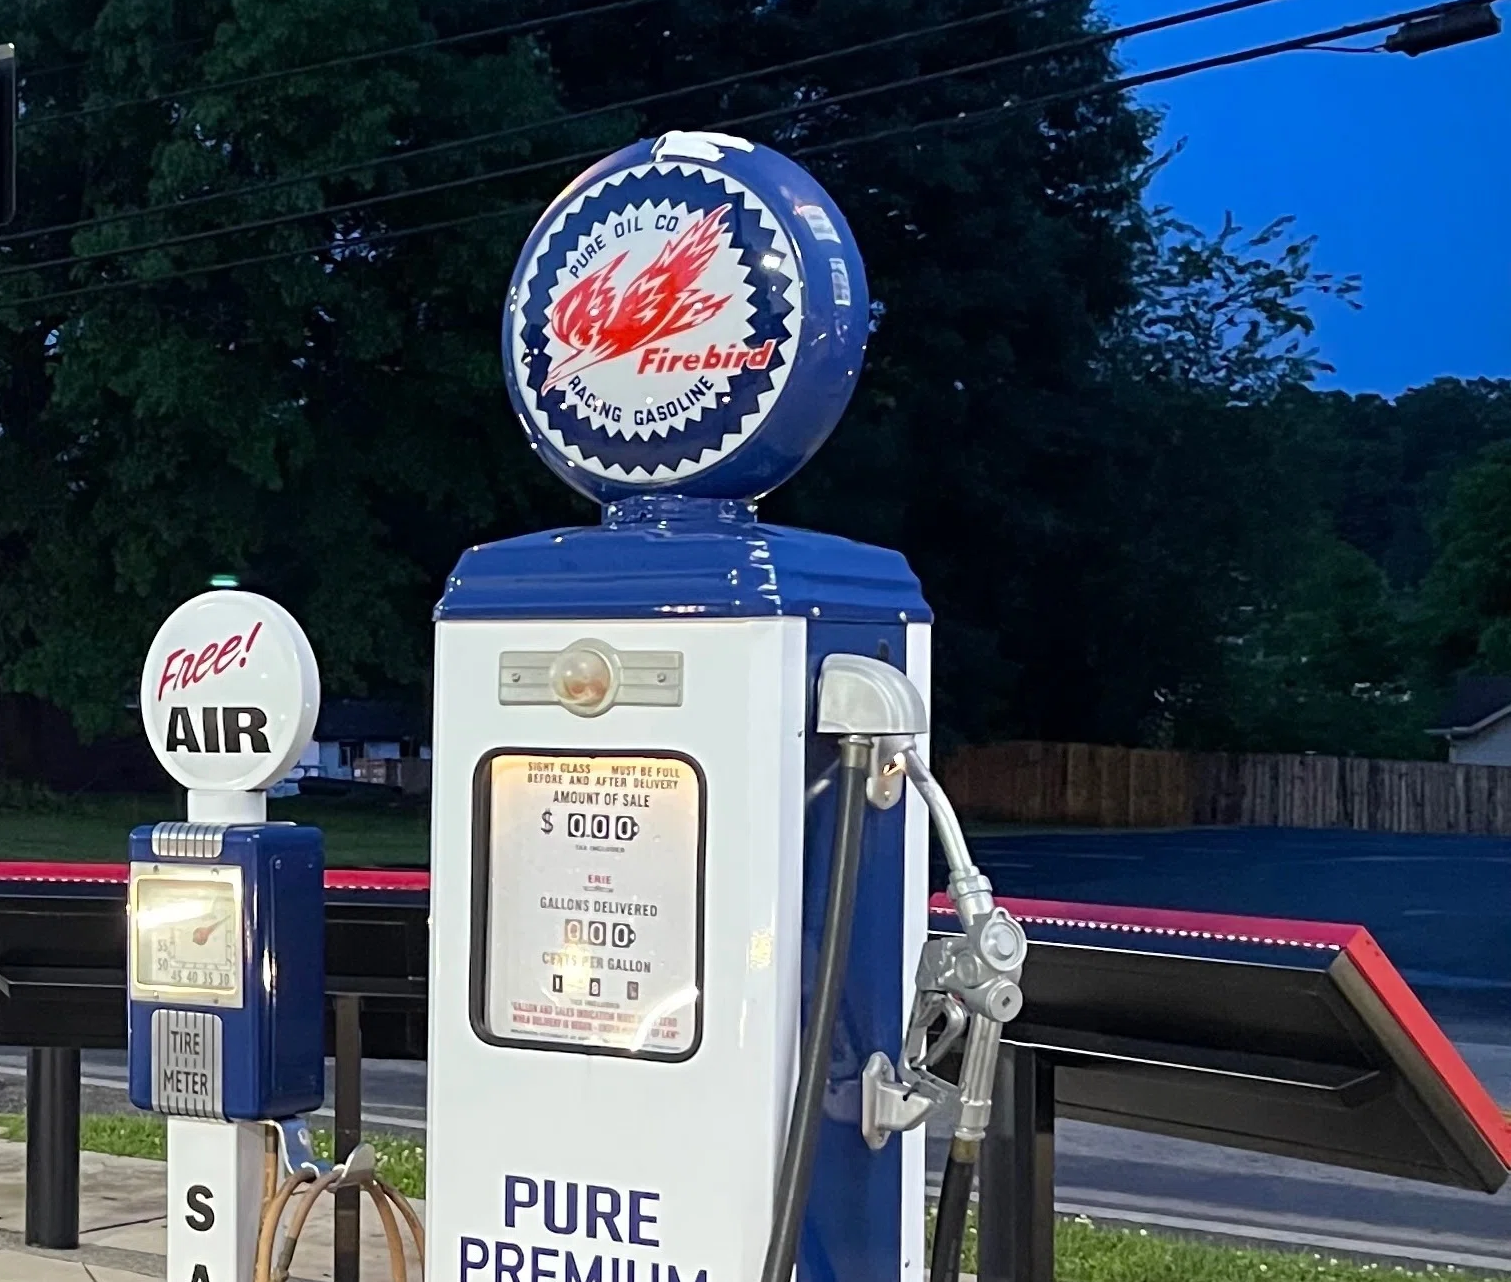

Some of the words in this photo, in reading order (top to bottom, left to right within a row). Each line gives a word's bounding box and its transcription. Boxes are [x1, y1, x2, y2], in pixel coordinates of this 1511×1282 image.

[569, 234, 607, 278] PURE
[614, 216, 643, 238] OIL
[637, 341, 774, 374] Firebird
[568, 375, 622, 423] RACING
[634, 376, 714, 425] GASOLINE
[158, 621, 262, 702] Free!
[166, 707, 271, 753] AIR
[527, 773, 563, 785] BEFORE
[569, 775, 589, 786] AND
[595, 776, 627, 787] AFTER
[633, 777, 679, 790] DELIVERY
[560, 763, 591, 774] GLASS
[611, 765, 637, 776] MUST
[640, 767, 653, 777] BE
[553, 790, 600, 806] AMOUNT
[604, 792, 619, 806] OF
[622, 793, 651, 808] SALE
[541, 808, 554, 835] $
[587, 875, 612, 884] ERIE
[540, 896, 589, 912] GALLONS
[594, 900, 658, 917] DELIVERED
[158, 958, 168, 970] 50
[608, 958, 651, 973] GALLON
[171, 970, 182, 982] 45
[187, 971, 198, 983] 40
[203, 972, 213, 985] 35
[170, 1030, 200, 1055] TIRE
[163, 1069, 208, 1096] METER
[504, 1175, 660, 1248] PURE
